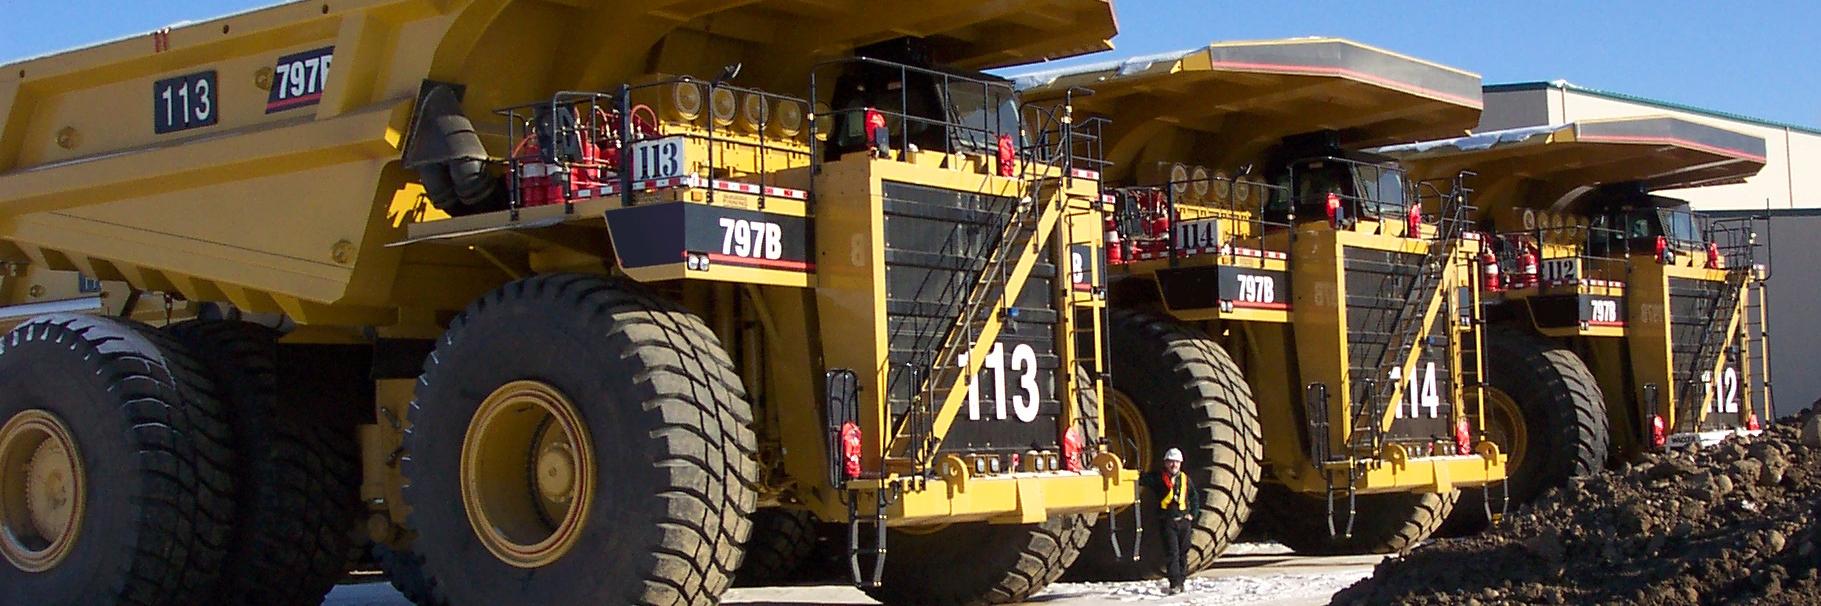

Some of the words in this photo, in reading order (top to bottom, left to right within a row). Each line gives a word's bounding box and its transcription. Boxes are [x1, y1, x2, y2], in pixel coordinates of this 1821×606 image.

[162, 79, 210, 126] 113
[640, 142, 679, 179] 113
[719, 217, 782, 260] 797B
[1182, 222, 1214, 249] 114
[1237, 274, 1274, 303] 797B
[1590, 299, 1617, 322] 797B
[957, 342, 1040, 422] 113
[1389, 362, 1439, 418] 114
[1701, 367, 1738, 413] 112
